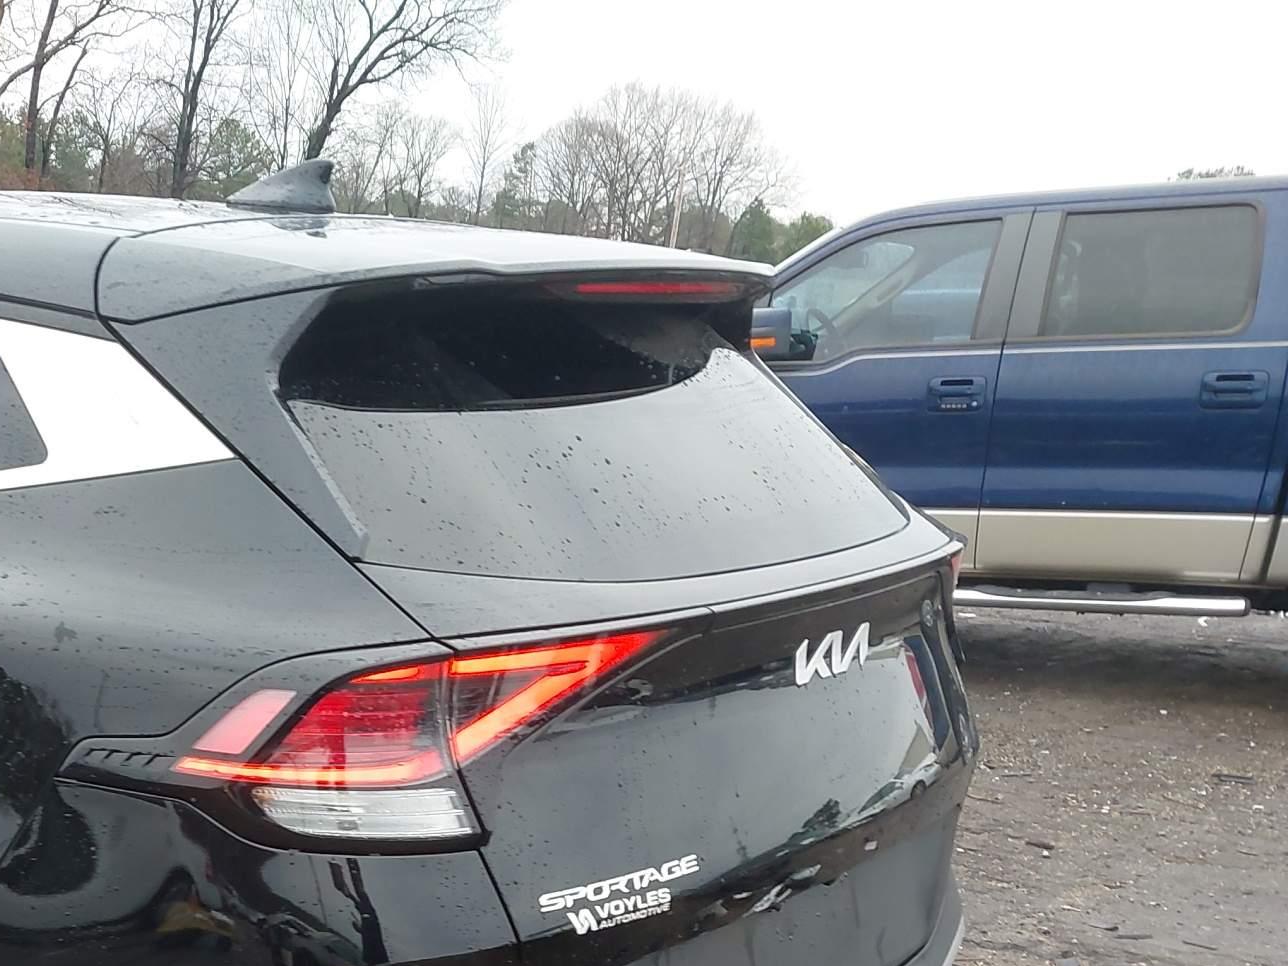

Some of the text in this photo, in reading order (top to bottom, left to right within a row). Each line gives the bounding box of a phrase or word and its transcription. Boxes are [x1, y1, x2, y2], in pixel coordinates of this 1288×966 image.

[795, 621, 870, 686] KIA
[538, 854, 700, 913] SPORTAGE
[594, 887, 672, 919] VOYLES
[599, 902, 671, 930] AUTOMOTIVE
